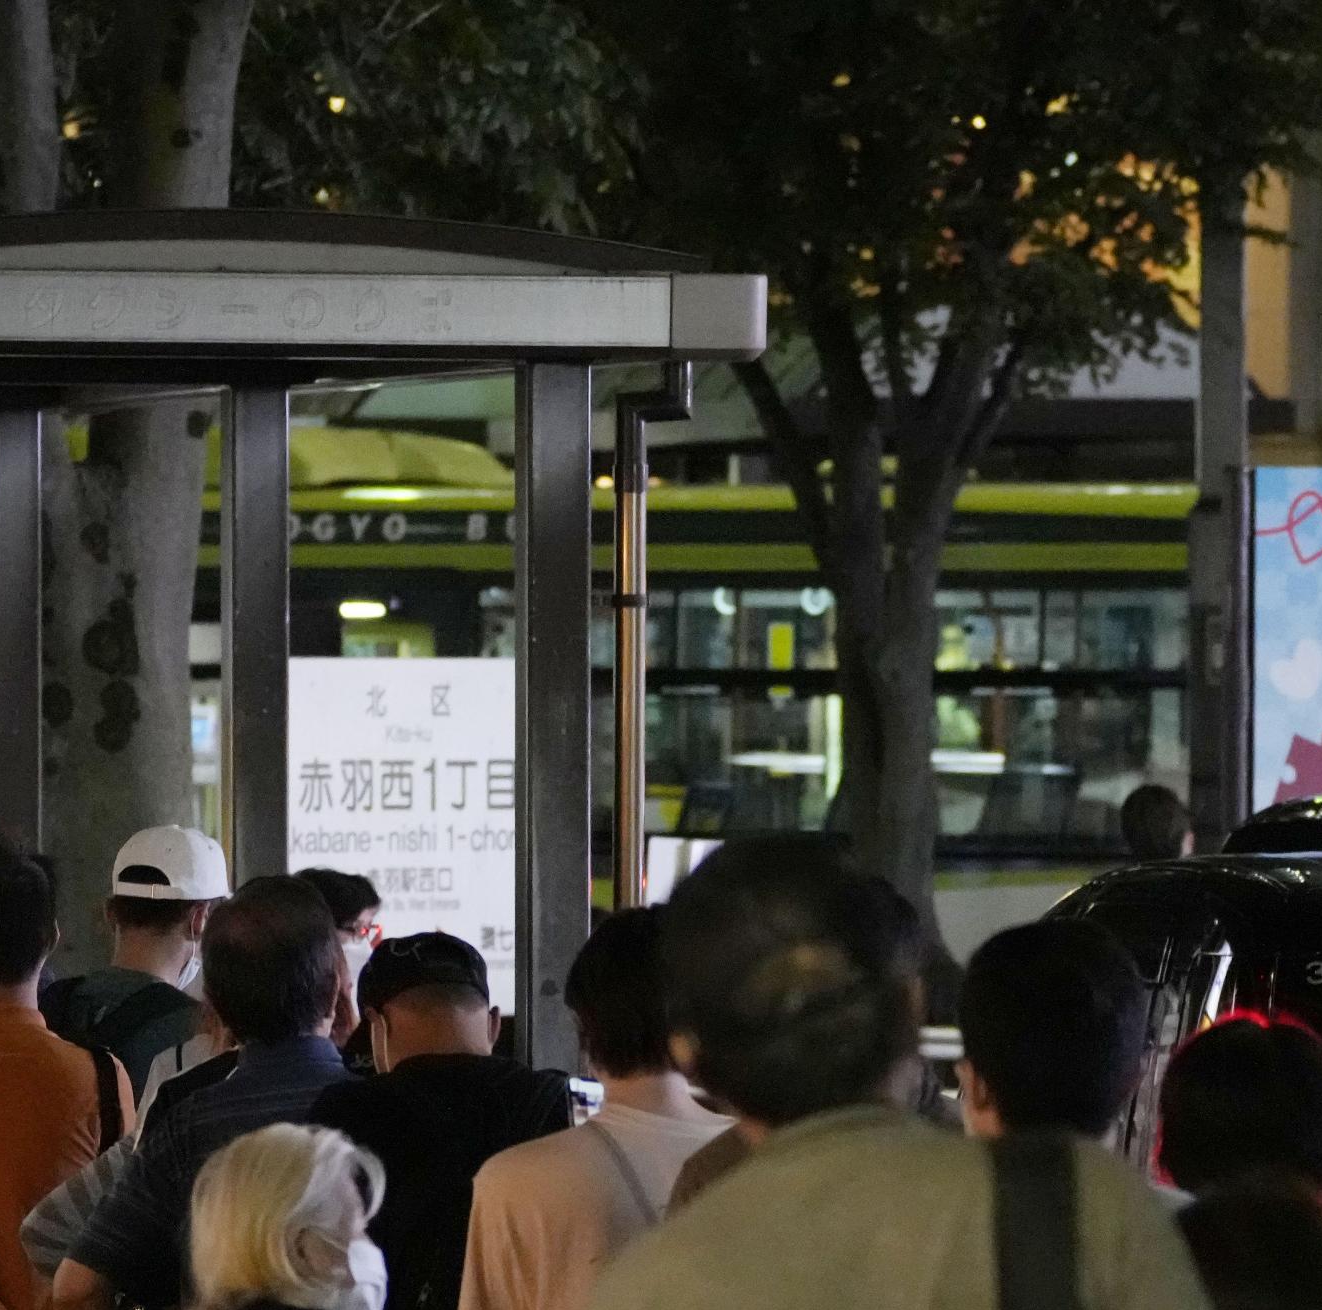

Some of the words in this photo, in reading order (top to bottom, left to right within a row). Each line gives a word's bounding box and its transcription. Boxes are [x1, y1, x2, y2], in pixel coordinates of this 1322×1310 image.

[298, 757, 515, 813] 赤羽西1丁目
[290, 824, 438, 854] kabane-nishi
